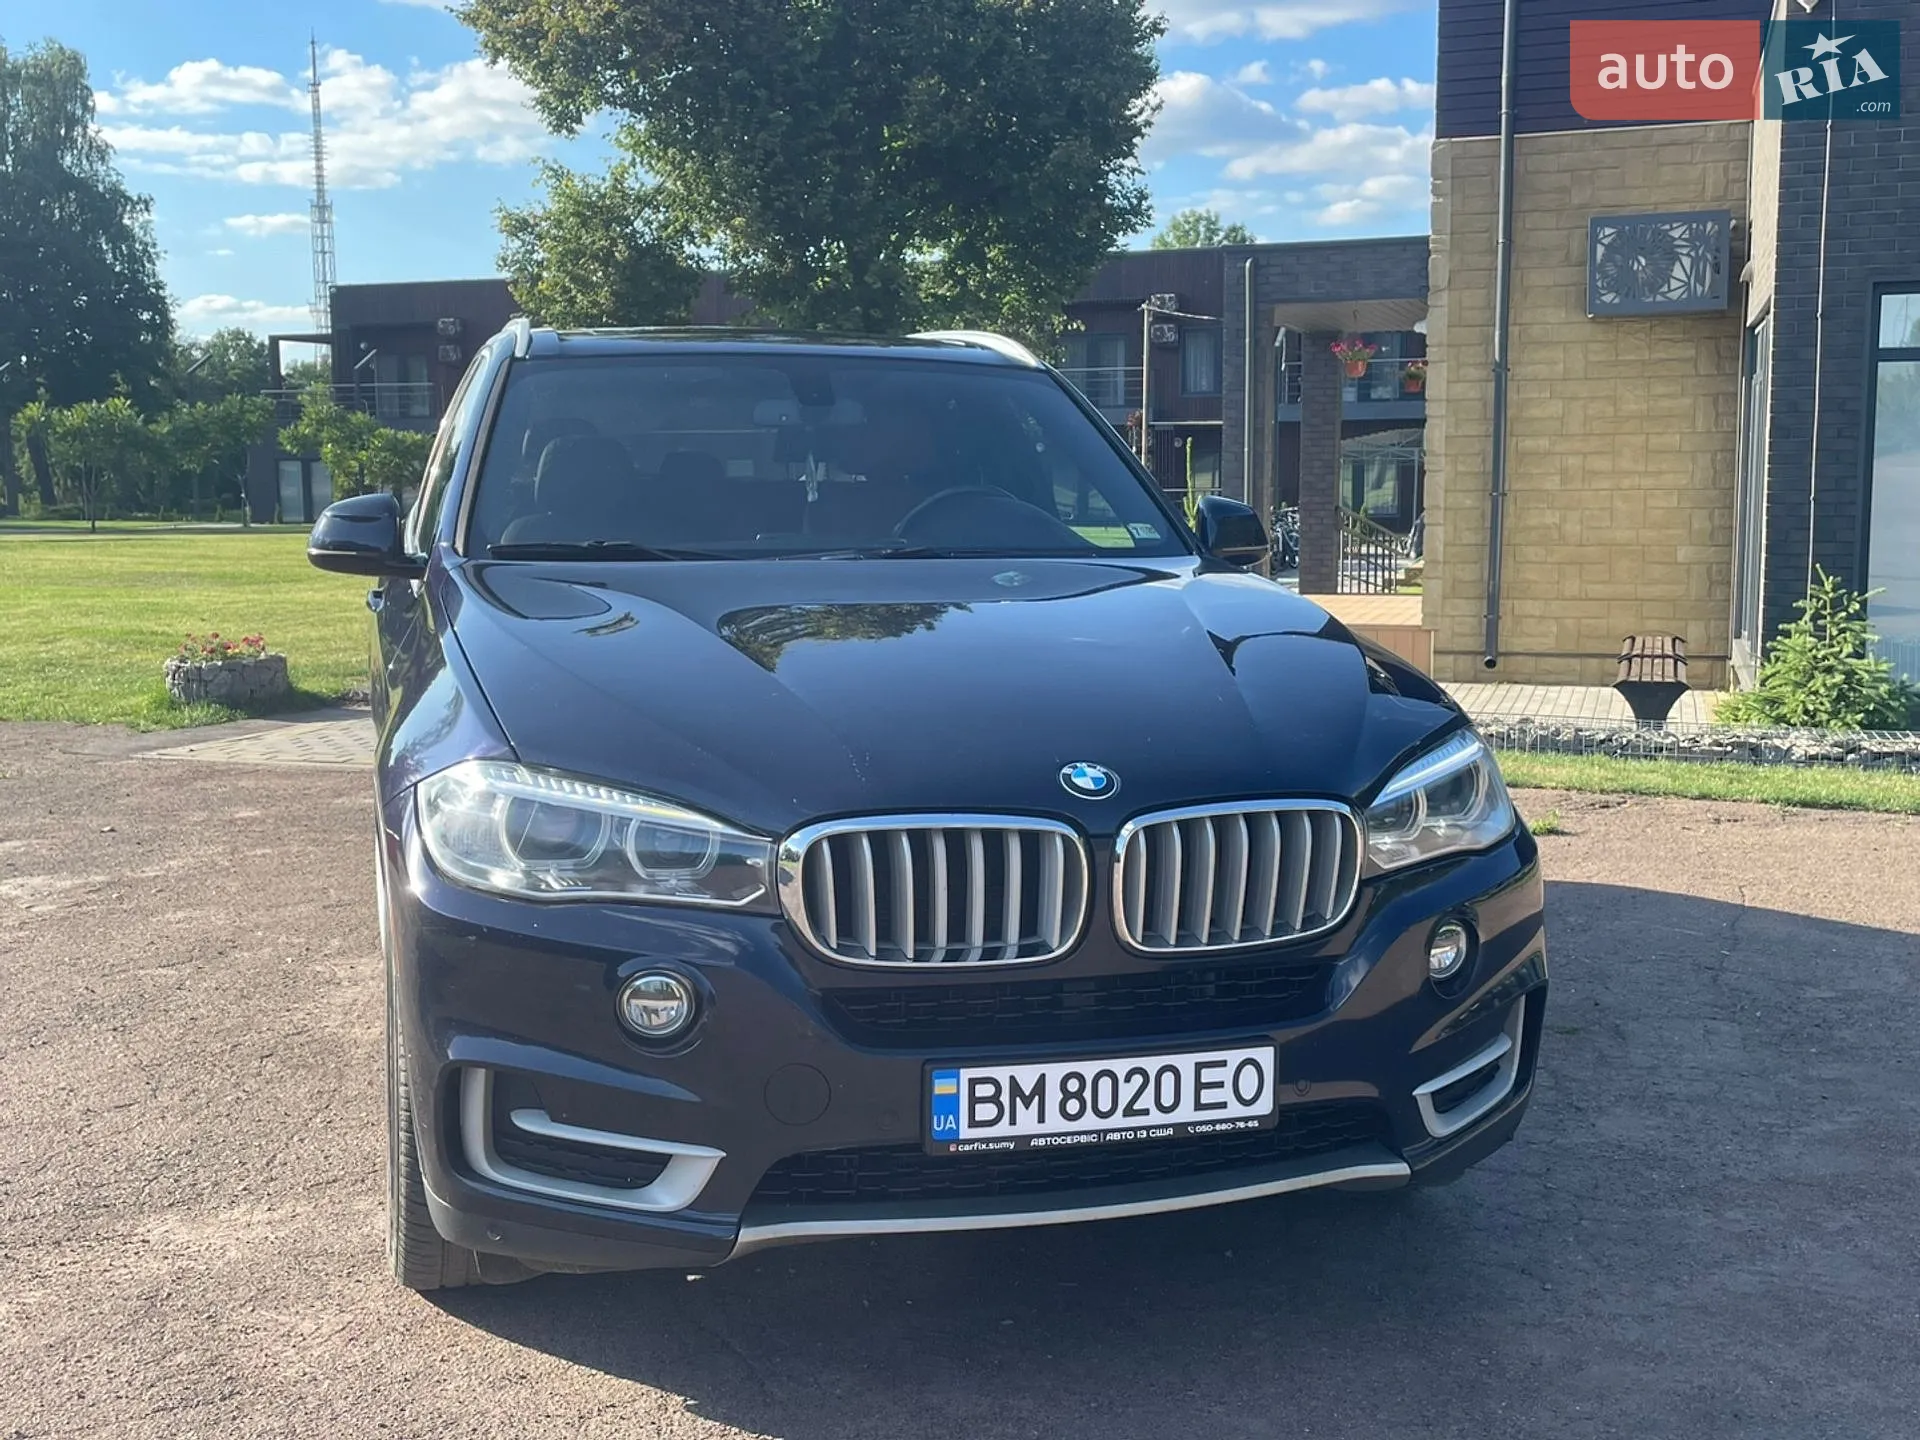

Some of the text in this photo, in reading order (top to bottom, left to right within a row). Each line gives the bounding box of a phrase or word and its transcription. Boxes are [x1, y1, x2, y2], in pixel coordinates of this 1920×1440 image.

[967, 1057, 1265, 1129] BM 8020 EO
[933, 1114, 957, 1131] UA
[958, 1140, 1015, 1151] carfix.sumy
[1030, 1133, 1098, 1147] АВТОСЕРВІС
[1105, 1128, 1135, 1141] АВТО
[1149, 1127, 1174, 1137] США
